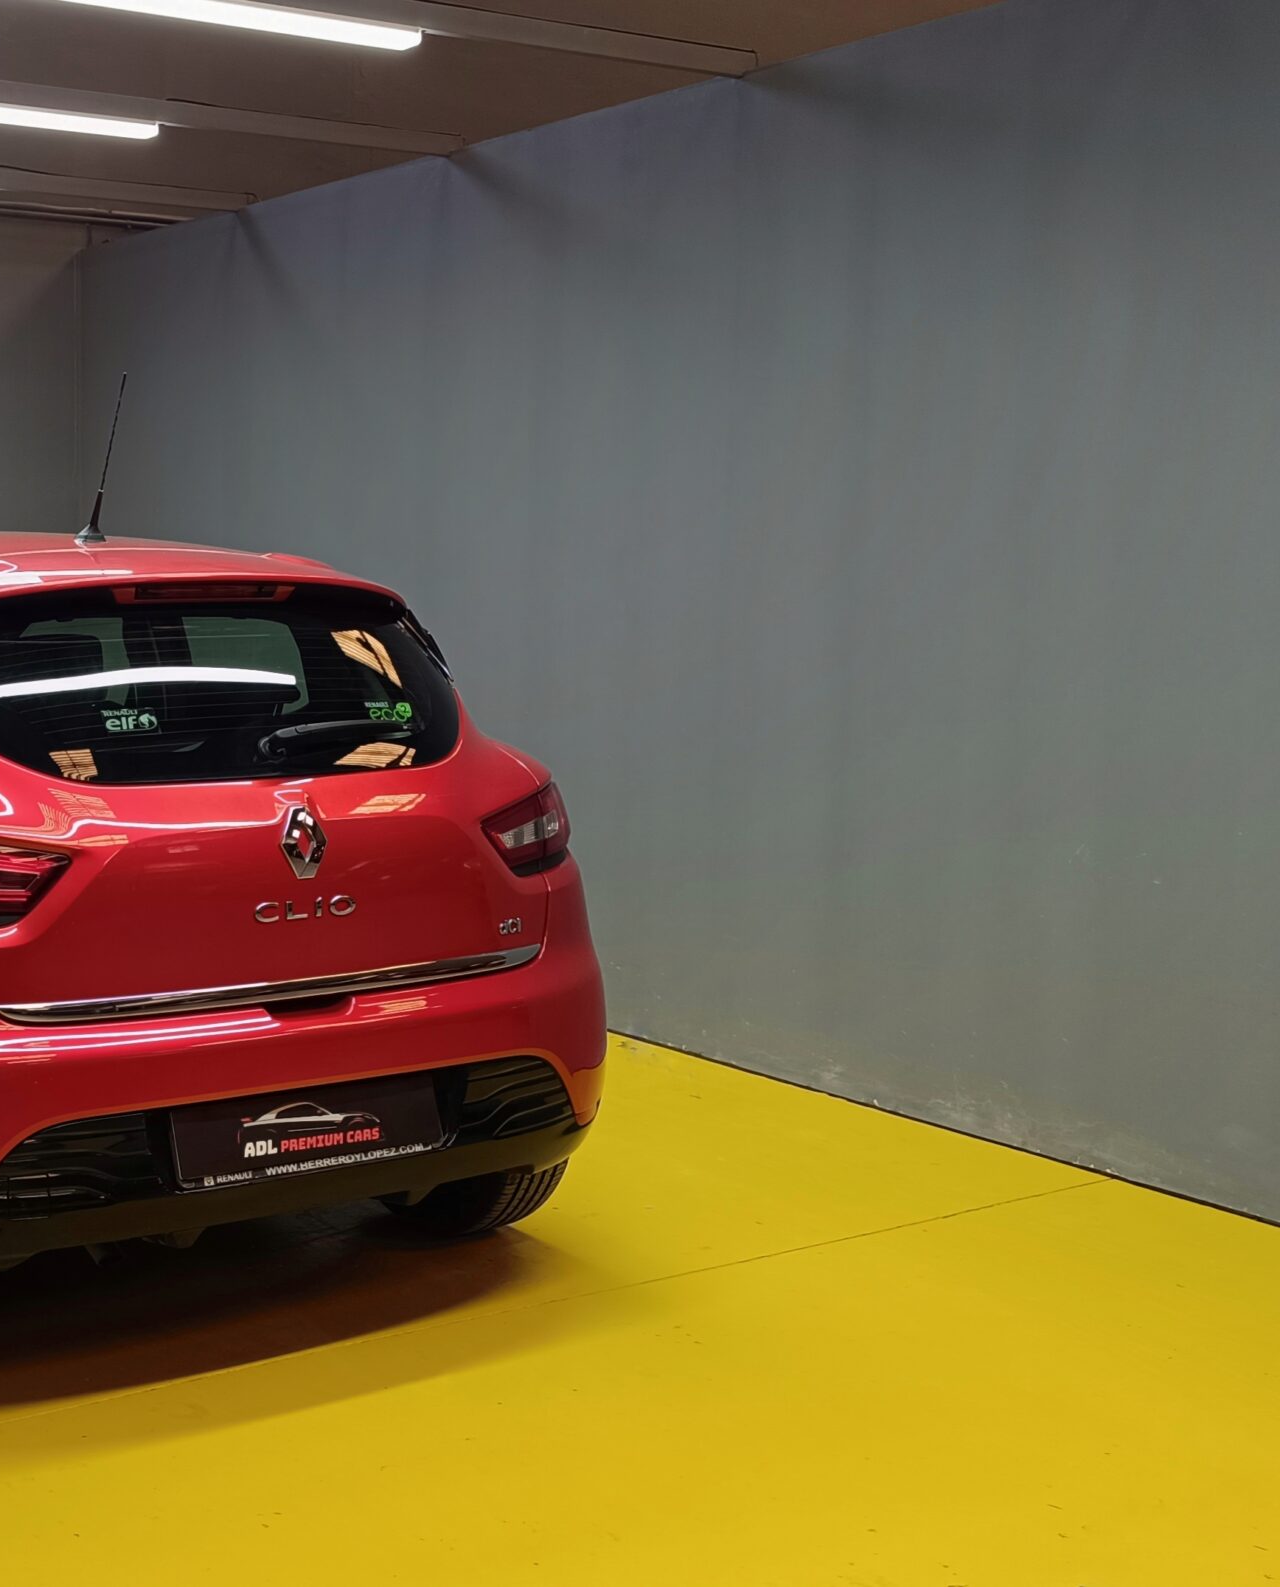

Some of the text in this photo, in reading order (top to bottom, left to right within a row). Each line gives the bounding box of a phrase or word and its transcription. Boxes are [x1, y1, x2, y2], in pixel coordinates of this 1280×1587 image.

[106, 716, 137, 730] elf
[255, 894, 357, 923] CLIO
[243, 1127, 380, 1158] ADL PREMIUM CARS
[216, 1170, 253, 1184] RENAULT
